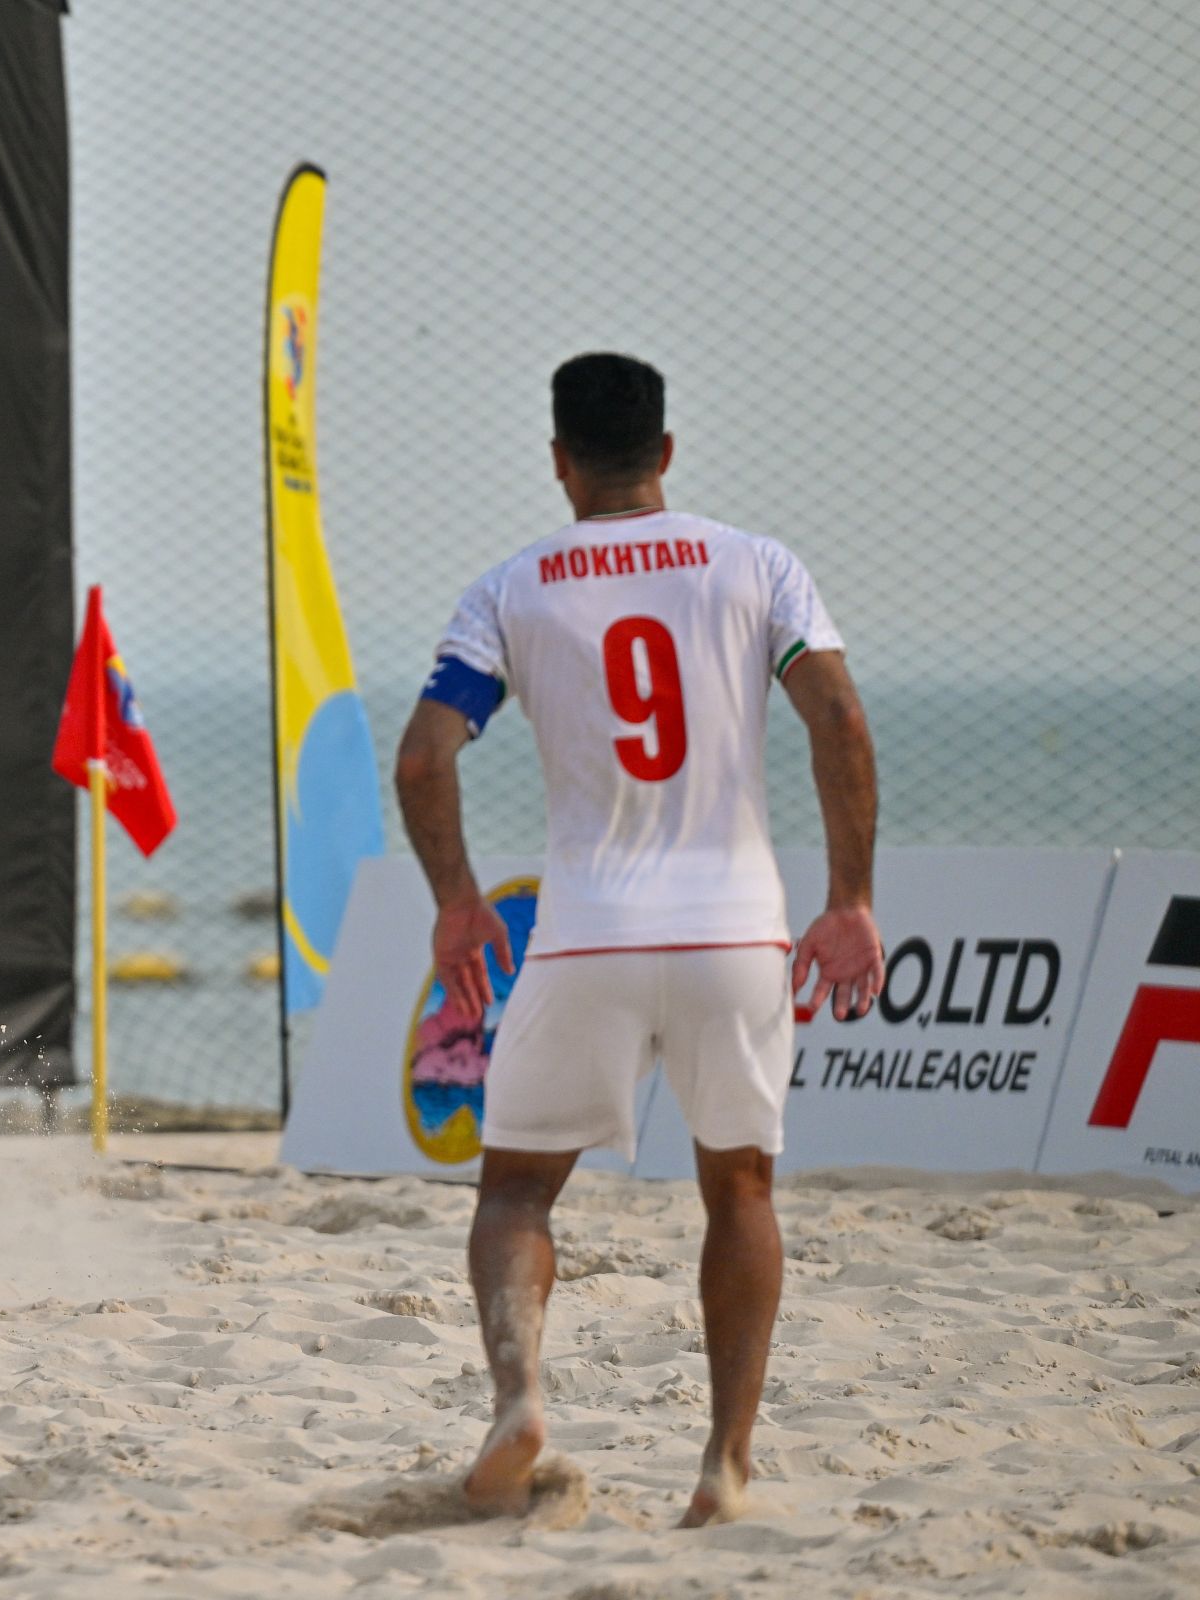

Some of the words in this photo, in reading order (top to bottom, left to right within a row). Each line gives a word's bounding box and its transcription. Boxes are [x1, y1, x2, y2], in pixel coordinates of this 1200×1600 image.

[539, 538, 709, 585] MOKHTARI
[603, 614, 688, 784] 9
[820, 1046, 1037, 1092] THAILEAGUE
